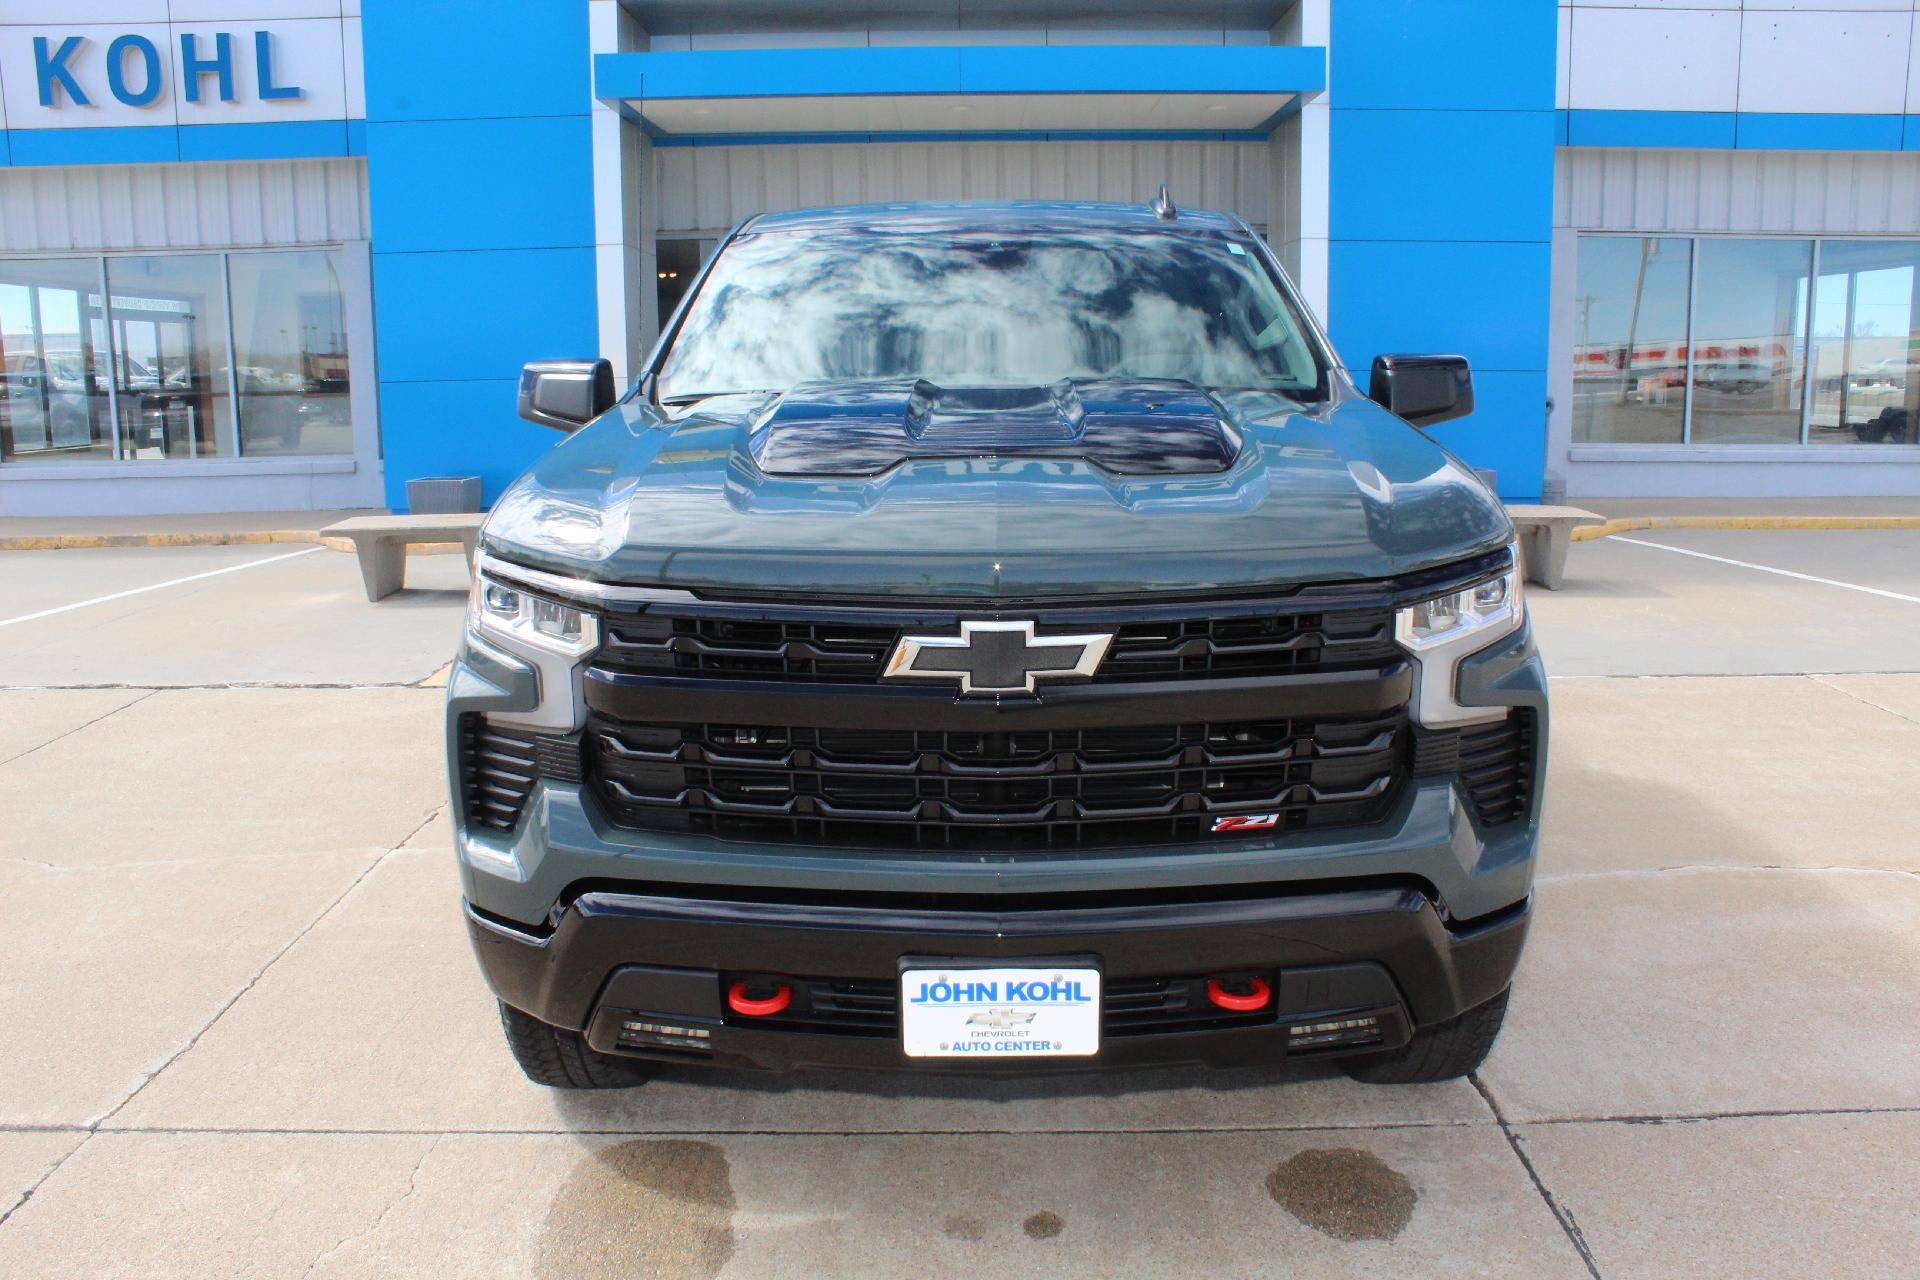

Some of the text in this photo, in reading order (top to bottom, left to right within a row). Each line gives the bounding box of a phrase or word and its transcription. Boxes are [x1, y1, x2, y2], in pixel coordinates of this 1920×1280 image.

[33, 31, 303, 108] KOHL
[911, 980, 1092, 1003] JOHN KOHL
[952, 1040, 1051, 1052] AUTO CENTER
